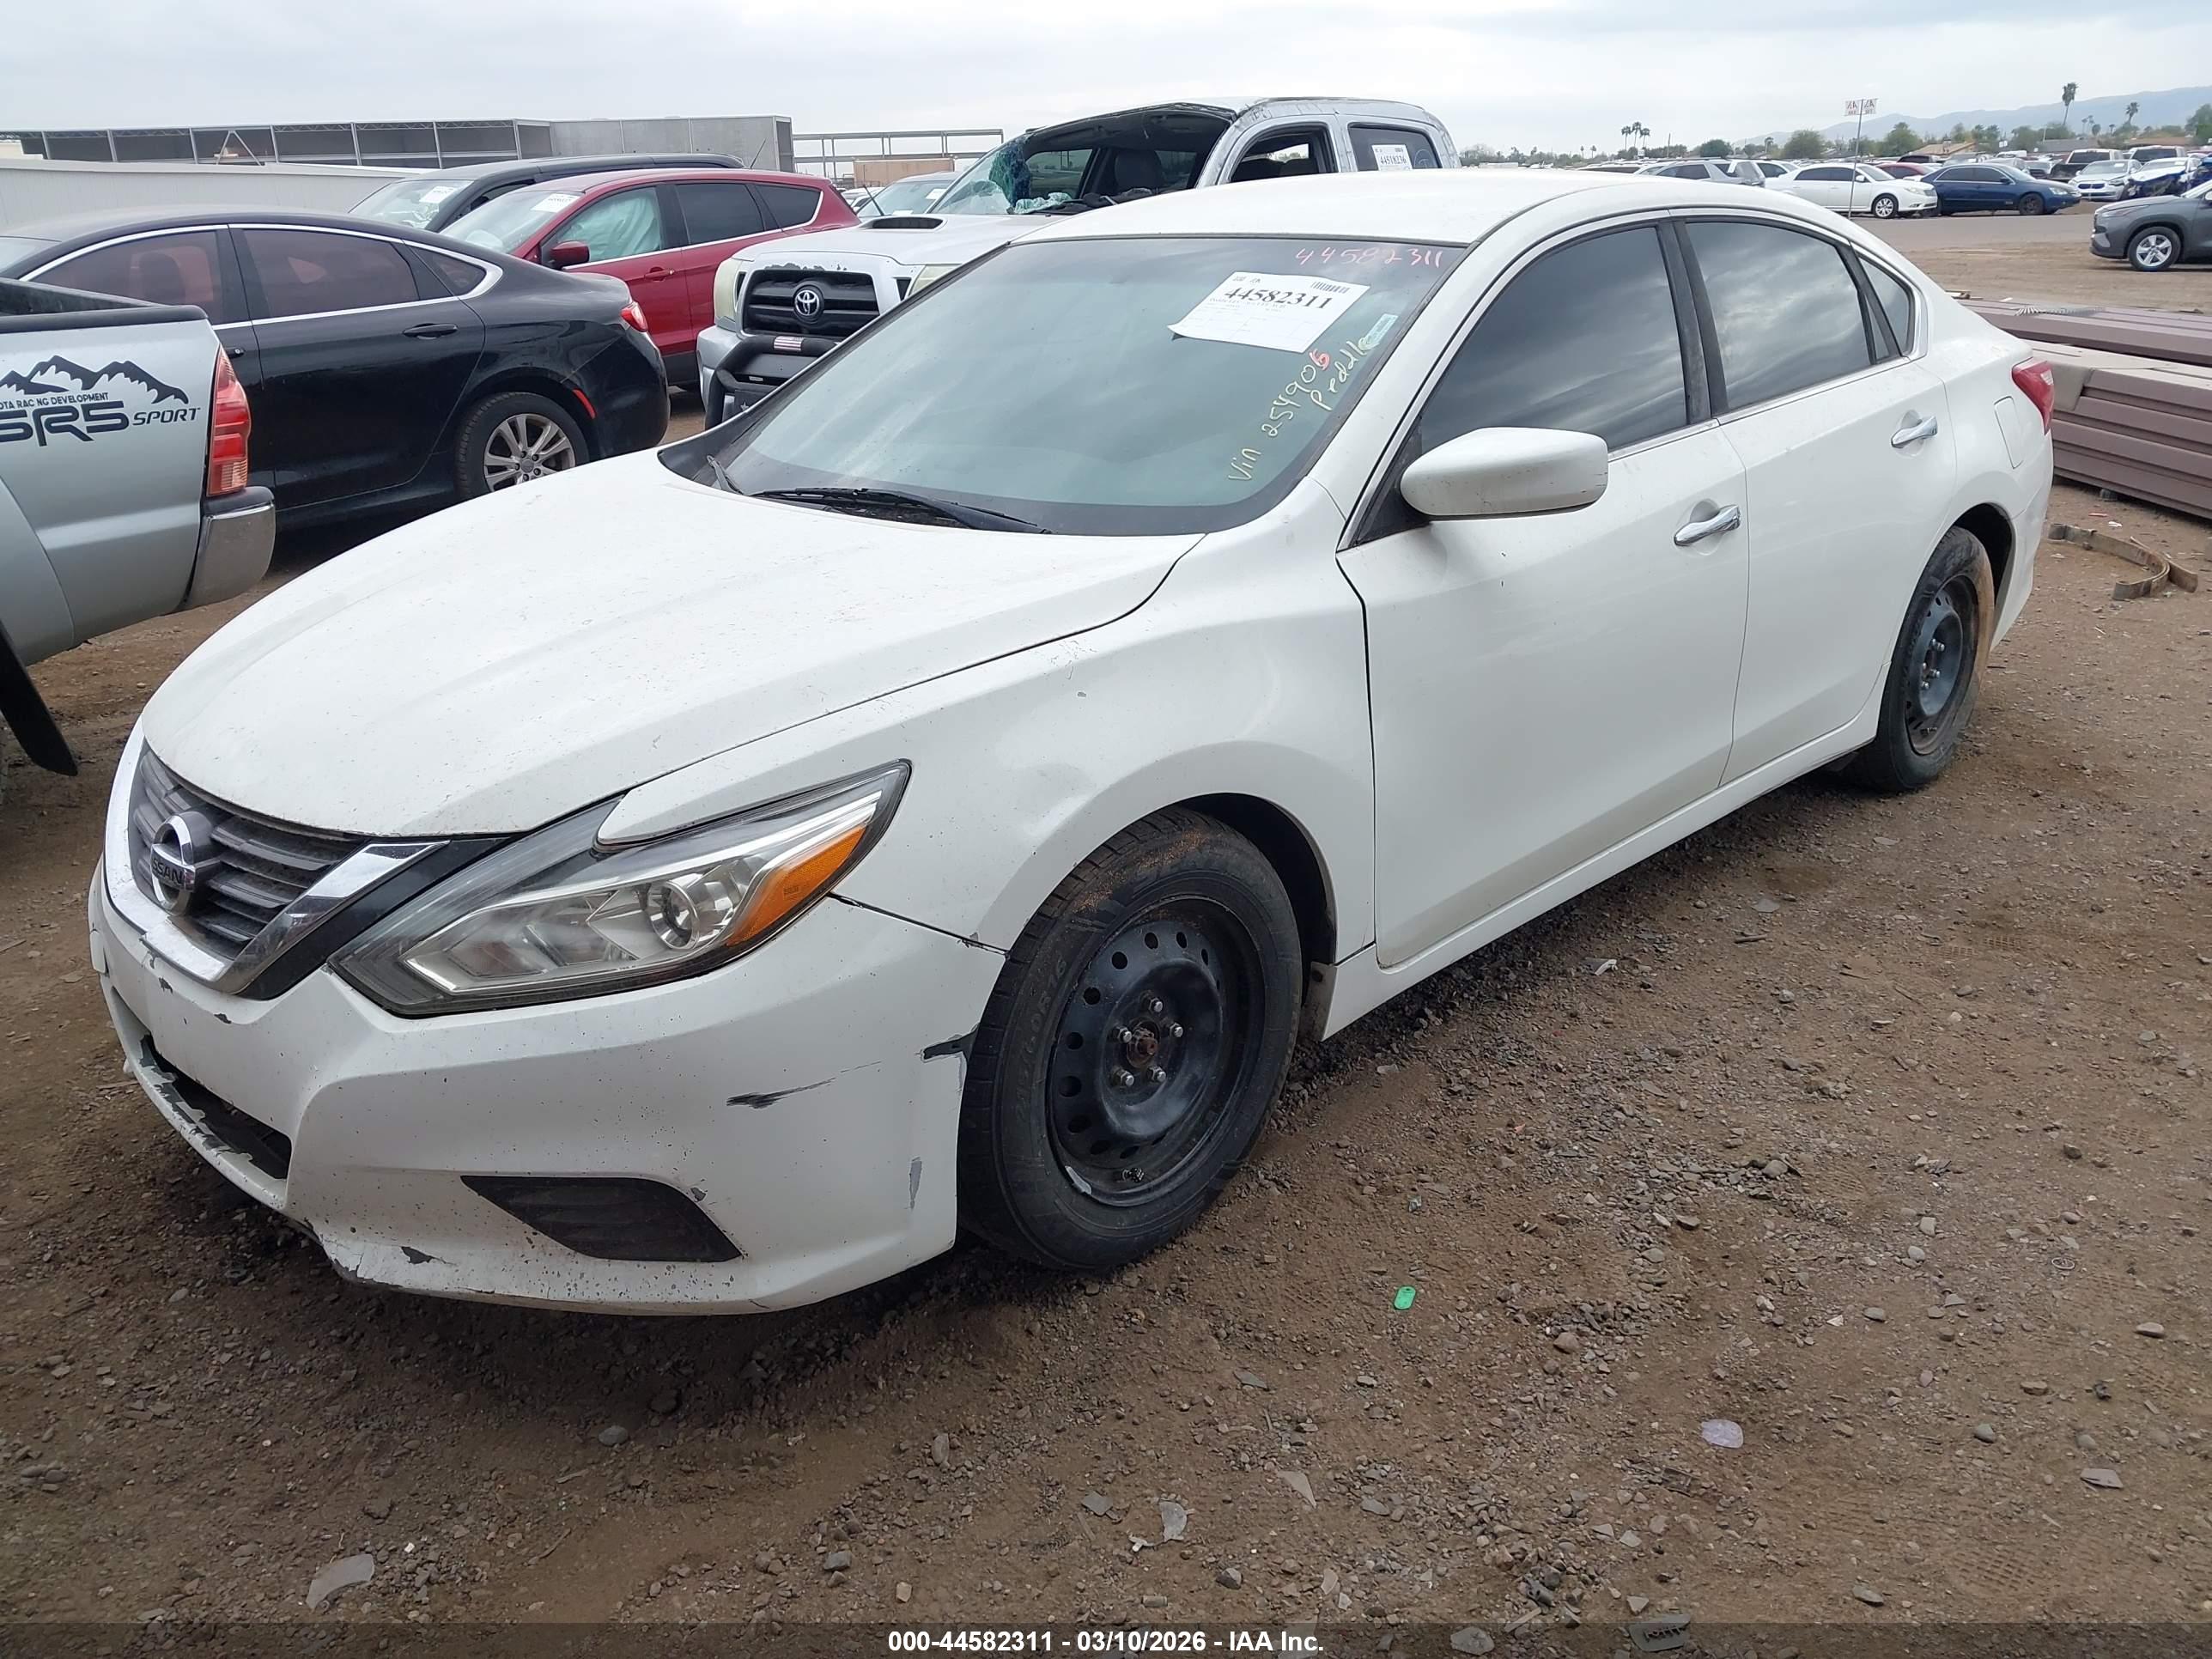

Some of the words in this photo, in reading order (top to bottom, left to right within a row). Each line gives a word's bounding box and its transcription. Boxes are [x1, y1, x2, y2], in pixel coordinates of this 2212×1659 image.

[1296, 246, 1443, 269] 44582311
[1224, 286, 1334, 309] 44582311
[51, 392, 110, 405] DEVELOPMENT
[132, 408, 198, 426] SPORT
